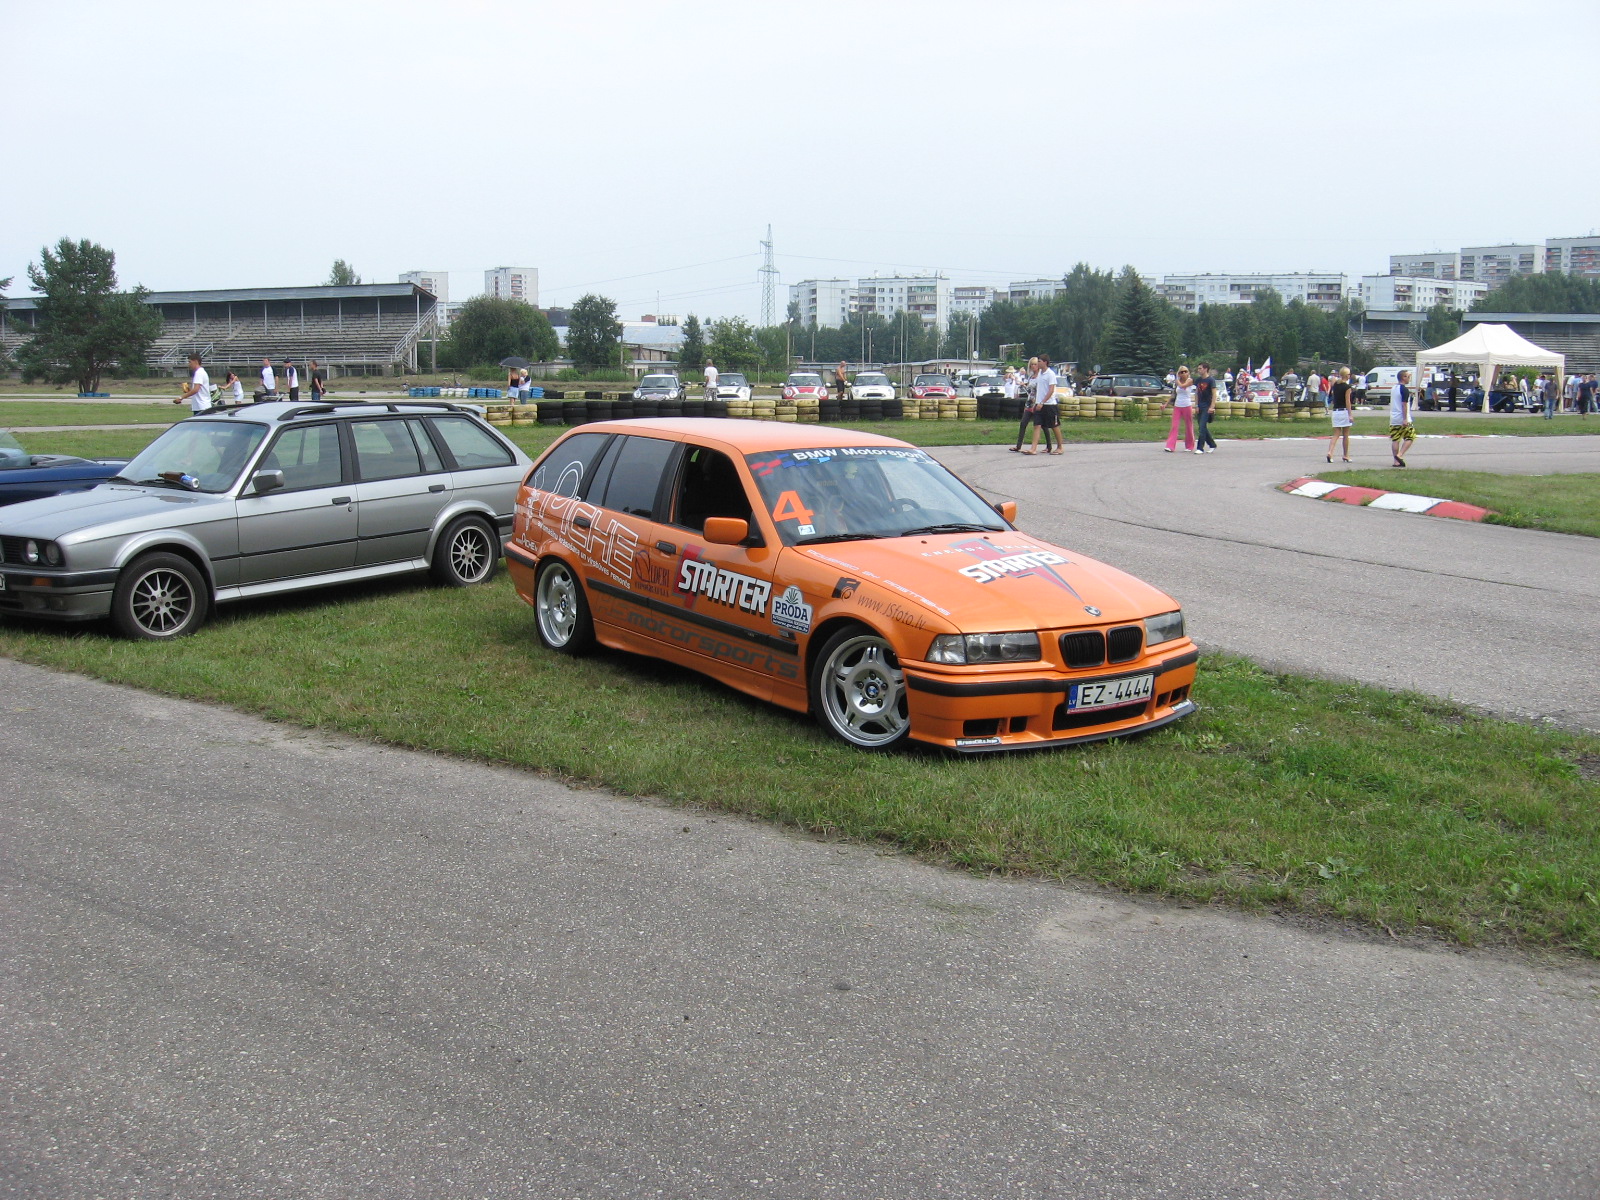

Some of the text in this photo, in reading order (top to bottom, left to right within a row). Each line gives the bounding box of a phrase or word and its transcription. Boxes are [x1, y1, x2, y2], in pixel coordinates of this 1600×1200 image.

[793, 449, 837, 461] BMW
[771, 490, 815, 525] 4
[678, 558, 773, 616] STARTER
[774, 600, 809, 622] PRODA
[1068, 698, 1078, 706] LV
[1080, 677, 1150, 707] EZ-4444
